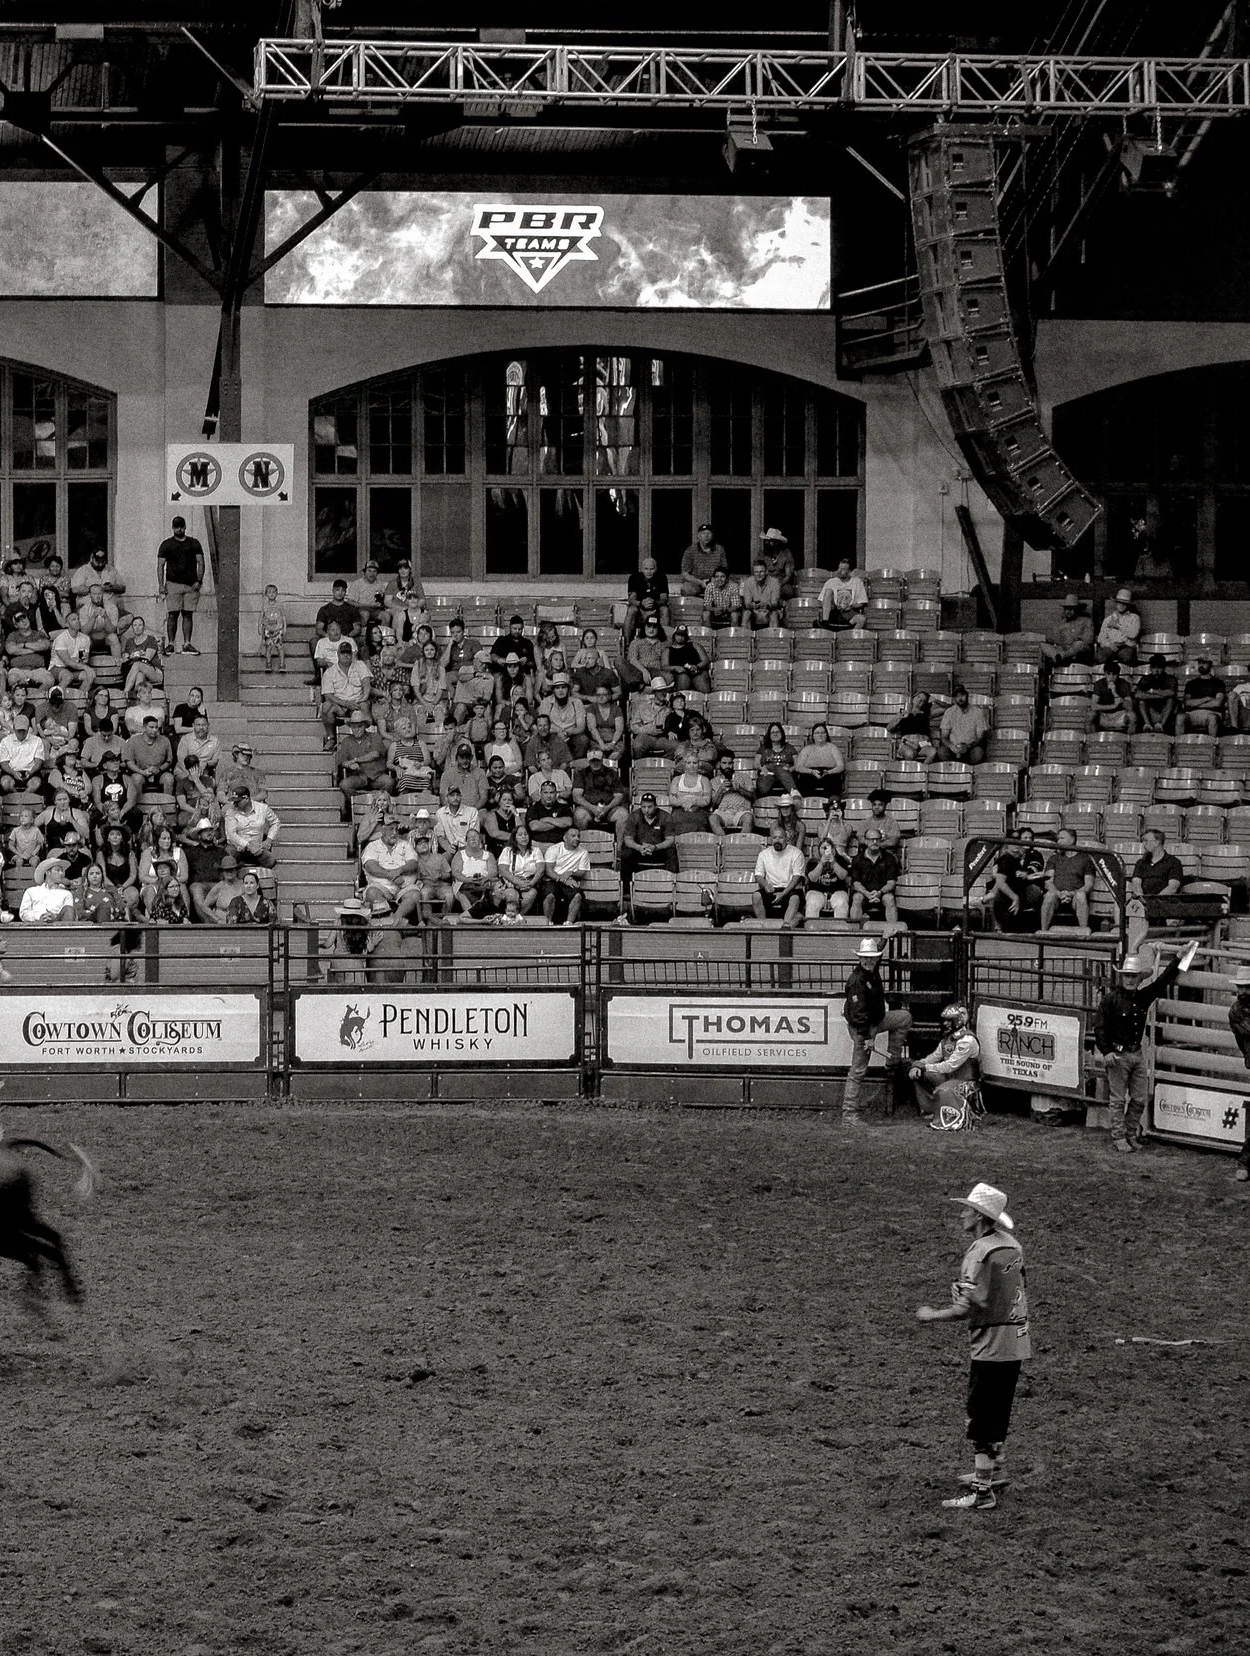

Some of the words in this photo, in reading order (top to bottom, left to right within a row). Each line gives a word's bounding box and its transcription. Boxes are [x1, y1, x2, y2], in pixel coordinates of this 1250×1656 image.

[478, 211, 598, 230] PBR
[504, 238, 570, 250] TEAMS
[188, 461, 211, 488] M
[252, 461, 271, 488] N
[379, 1003, 528, 1038] PENDLETON
[1034, 1018, 1048, 1030] FM
[681, 1015, 812, 1060] THOMAS
[413, 1038, 494, 1050] WHISKY
[42, 1047, 71, 1055] FORT
[76, 1047, 115, 1055] WORTH
[129, 1046, 203, 1055] STOCKYARDS
[702, 1047, 752, 1057] OILFIELD
[757, 1048, 807, 1058] SERVICES
[1000, 1057, 1015, 1066] THE
[1016, 1060, 1041, 1069] SOUND
[1042, 1064, 1053, 1072] OF
[1012, 1068, 1039, 1078] TEXAS
